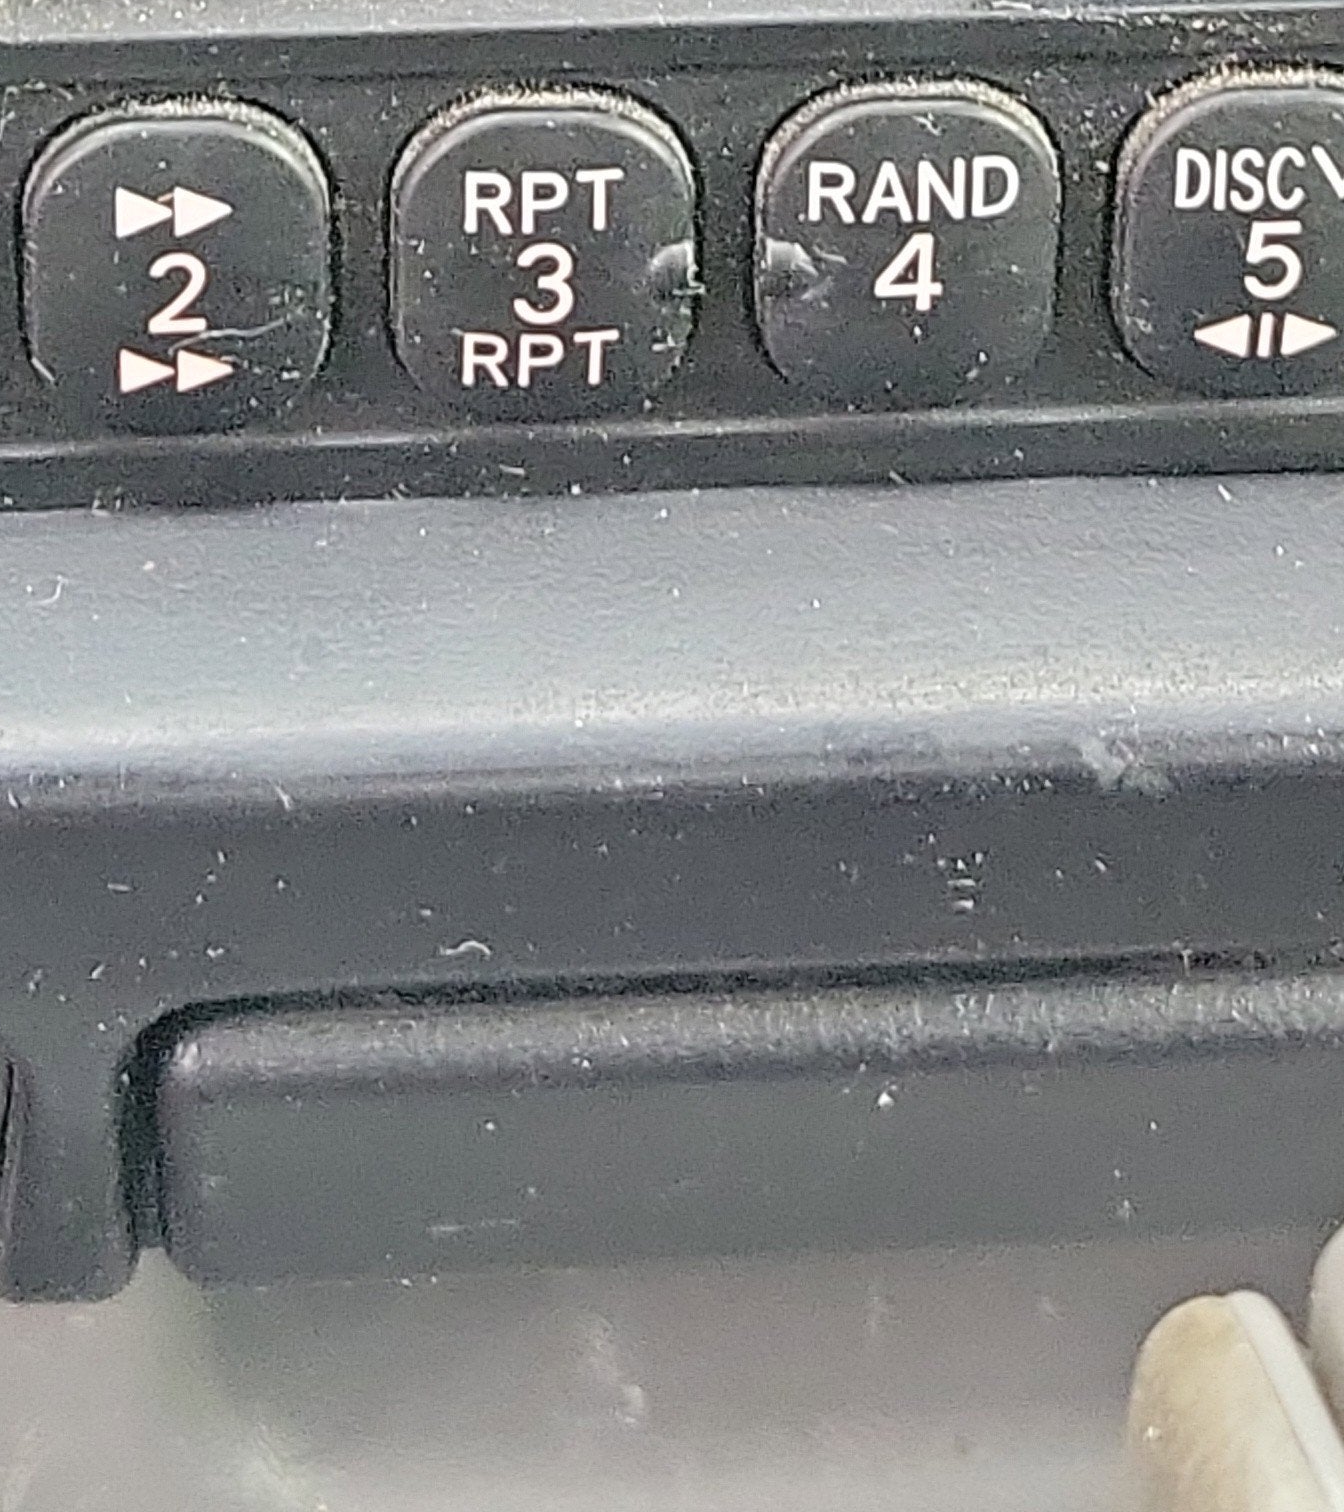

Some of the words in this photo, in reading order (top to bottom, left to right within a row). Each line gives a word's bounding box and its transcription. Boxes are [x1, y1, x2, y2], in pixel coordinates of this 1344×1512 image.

[463, 167, 624, 236] RPT
[807, 155, 1020, 225] RAND
[1173, 145, 1306, 213] DISC
[147, 252, 208, 336] 2
[513, 242, 575, 327] 3
[873, 232, 944, 314] 4
[1242, 220, 1303, 301] 5
[461, 328, 619, 389] RPT
